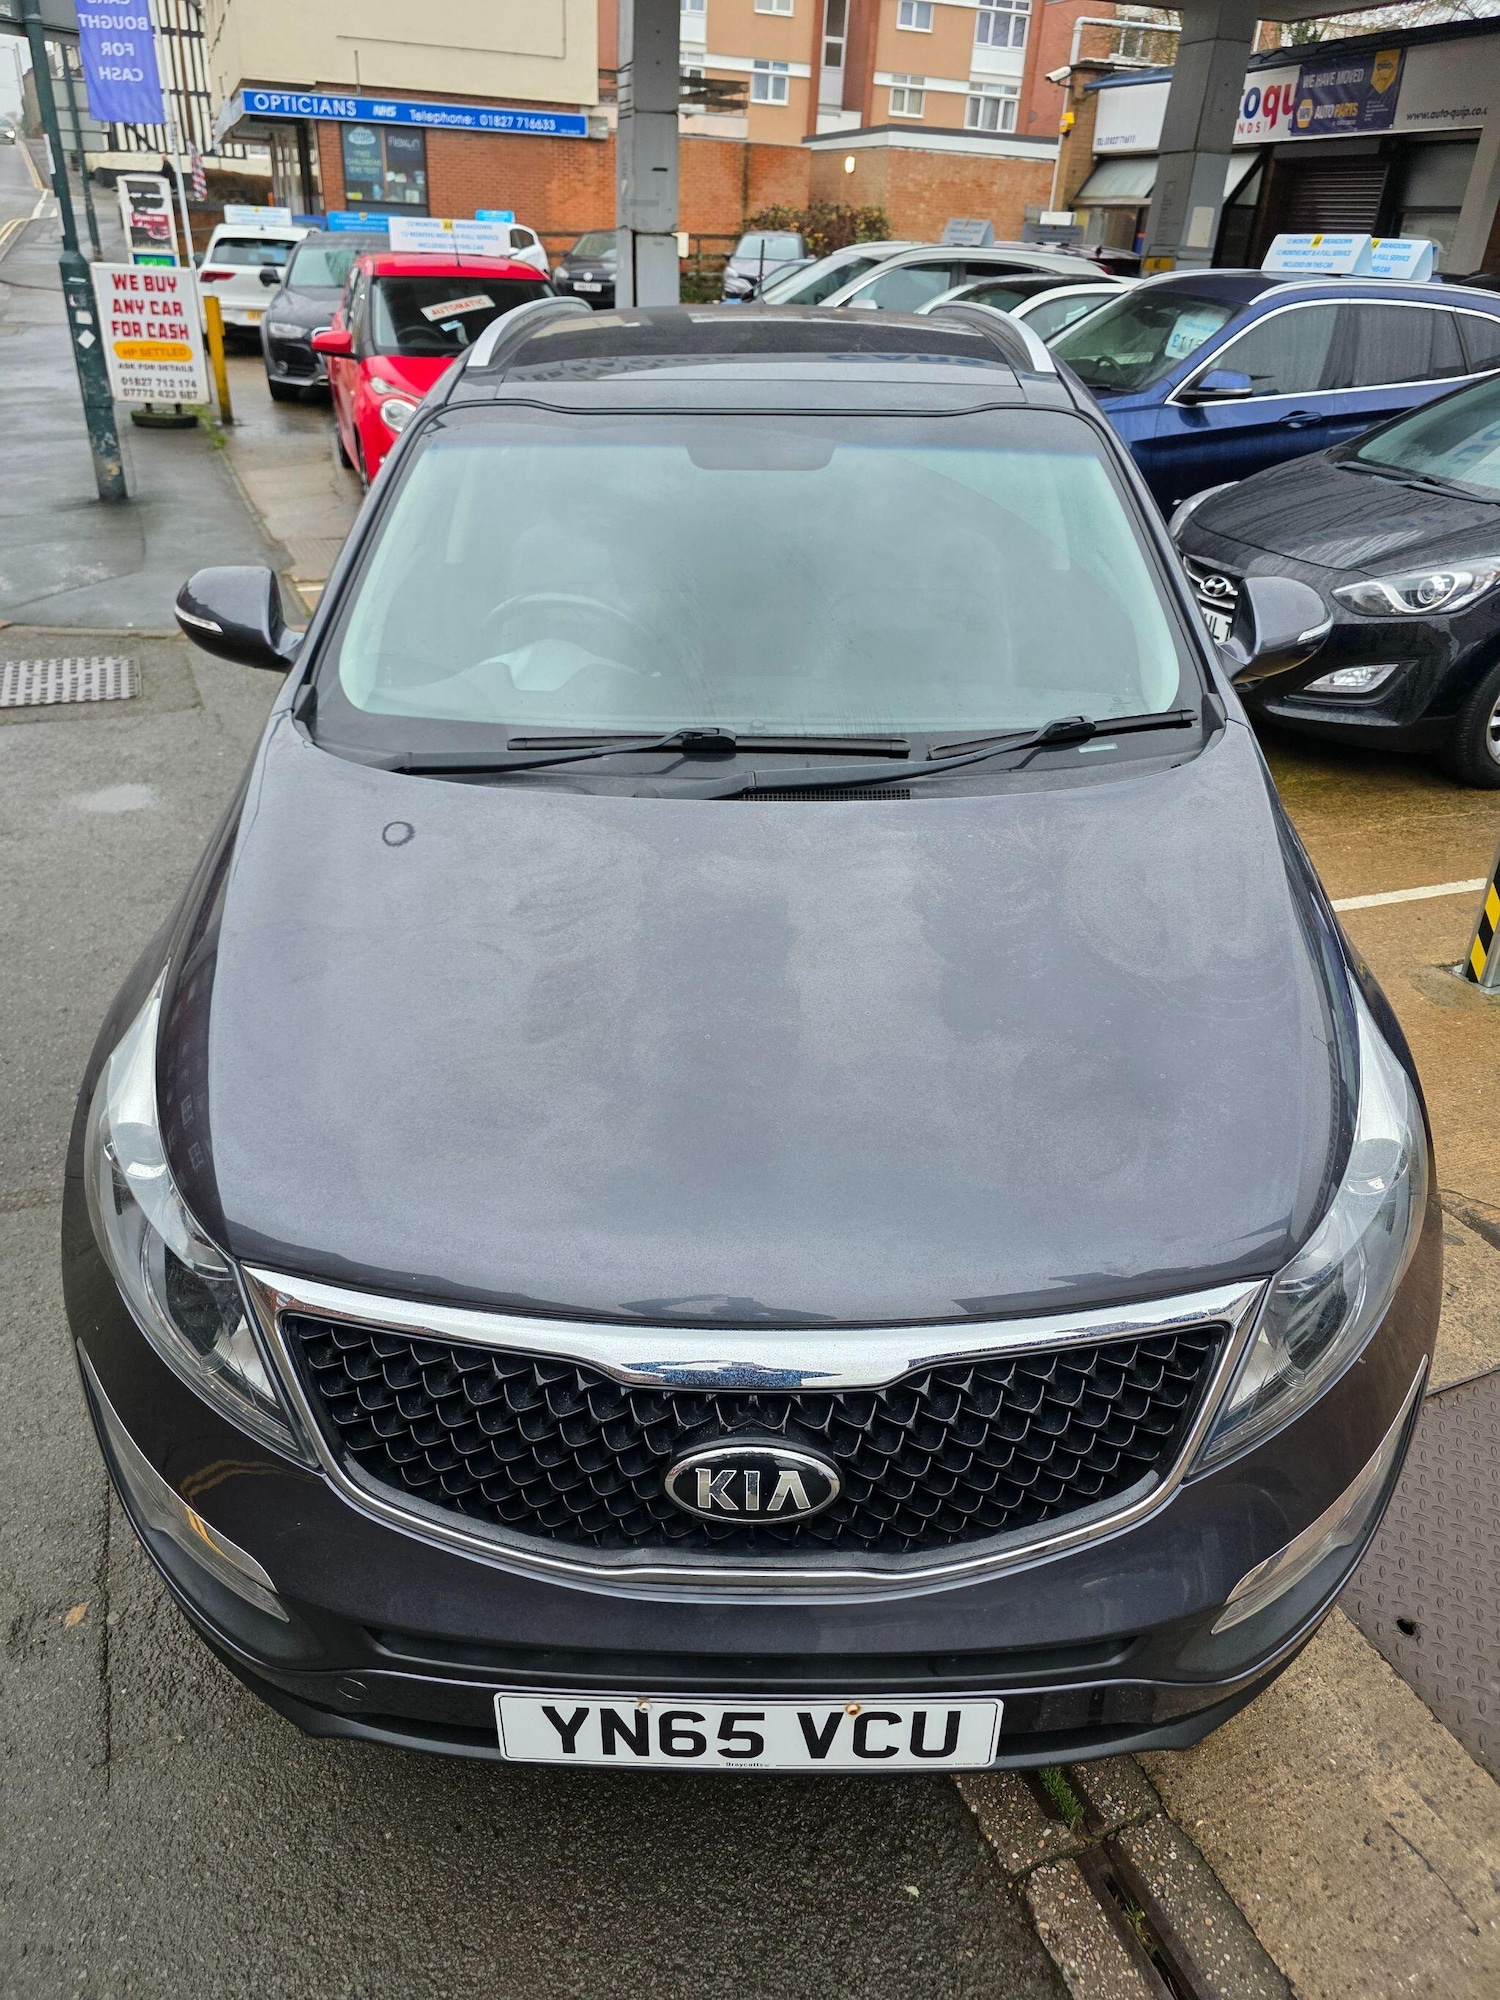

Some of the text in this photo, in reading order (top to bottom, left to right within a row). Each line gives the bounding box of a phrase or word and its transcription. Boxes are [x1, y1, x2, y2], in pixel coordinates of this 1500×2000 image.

[1303, 68, 1365, 88] WE HAVE MOVED
[253, 93, 357, 117] OPTICIANS
[373, 105, 397, 118] NHS
[409, 108, 476, 125] Telephone:
[479, 114, 513, 128] 01827
[1242, 83, 1297, 130] oqu
[1314, 105, 1334, 119] AUTO
[1334, 102, 1358, 118] PARTS
[1237, 121, 1261, 134] NDS
[112, 273, 177, 293] WE BUY
[113, 299, 183, 316] ANY CAR
[431, 298, 484, 316] AUTOMATIC
[112, 321, 189, 340] FOR CASH
[140, 347, 187, 357] SETTLED
[156, 378, 176, 388] 712
[695, 1468, 811, 1511] KIA
[541, 1705, 962, 1760] YN65 VCU
